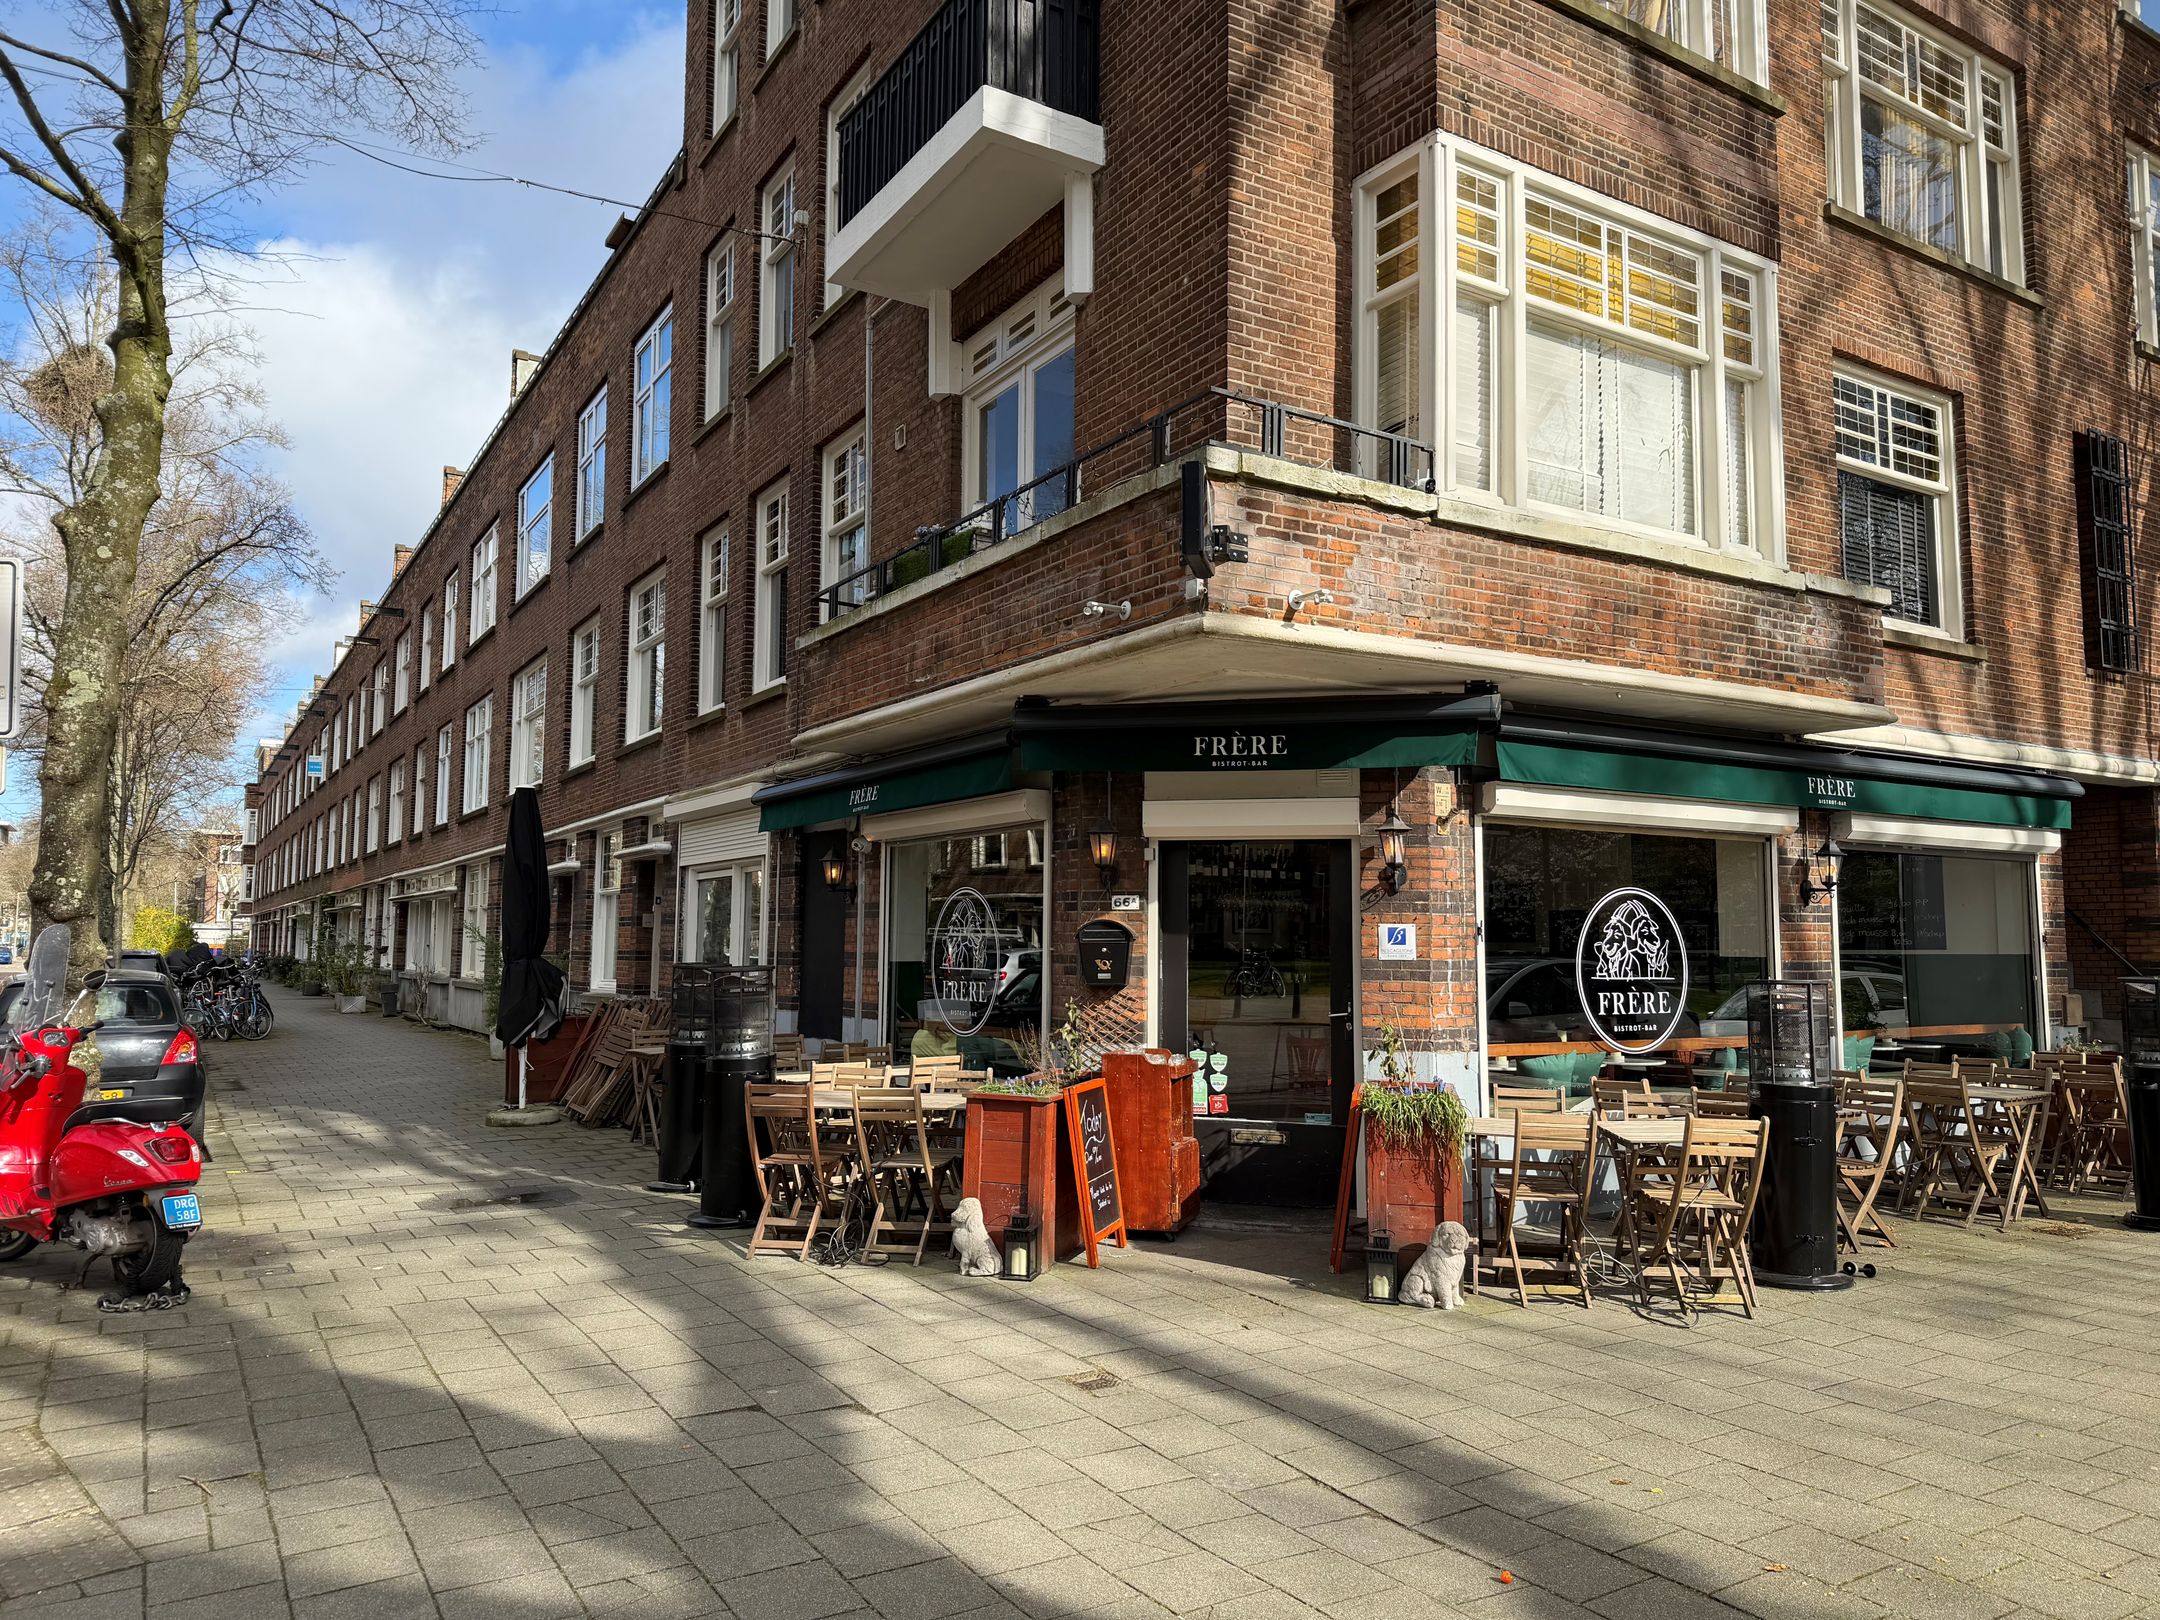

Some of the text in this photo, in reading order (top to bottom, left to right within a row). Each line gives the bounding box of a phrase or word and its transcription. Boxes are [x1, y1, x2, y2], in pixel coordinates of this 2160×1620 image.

[1193, 730, 1288, 756] FRÈRE
[849, 784, 880, 805] FRÈRE
[1807, 774, 1856, 798] FRÈRE
[942, 975, 987, 1003] FRÈRE
[1597, 986, 1672, 1016] FRÈRE
[1613, 1023, 1658, 1032] BISTROT-BAR
[174, 1198, 195, 1209] DRG
[176, 1209, 197, 1221] 58F
